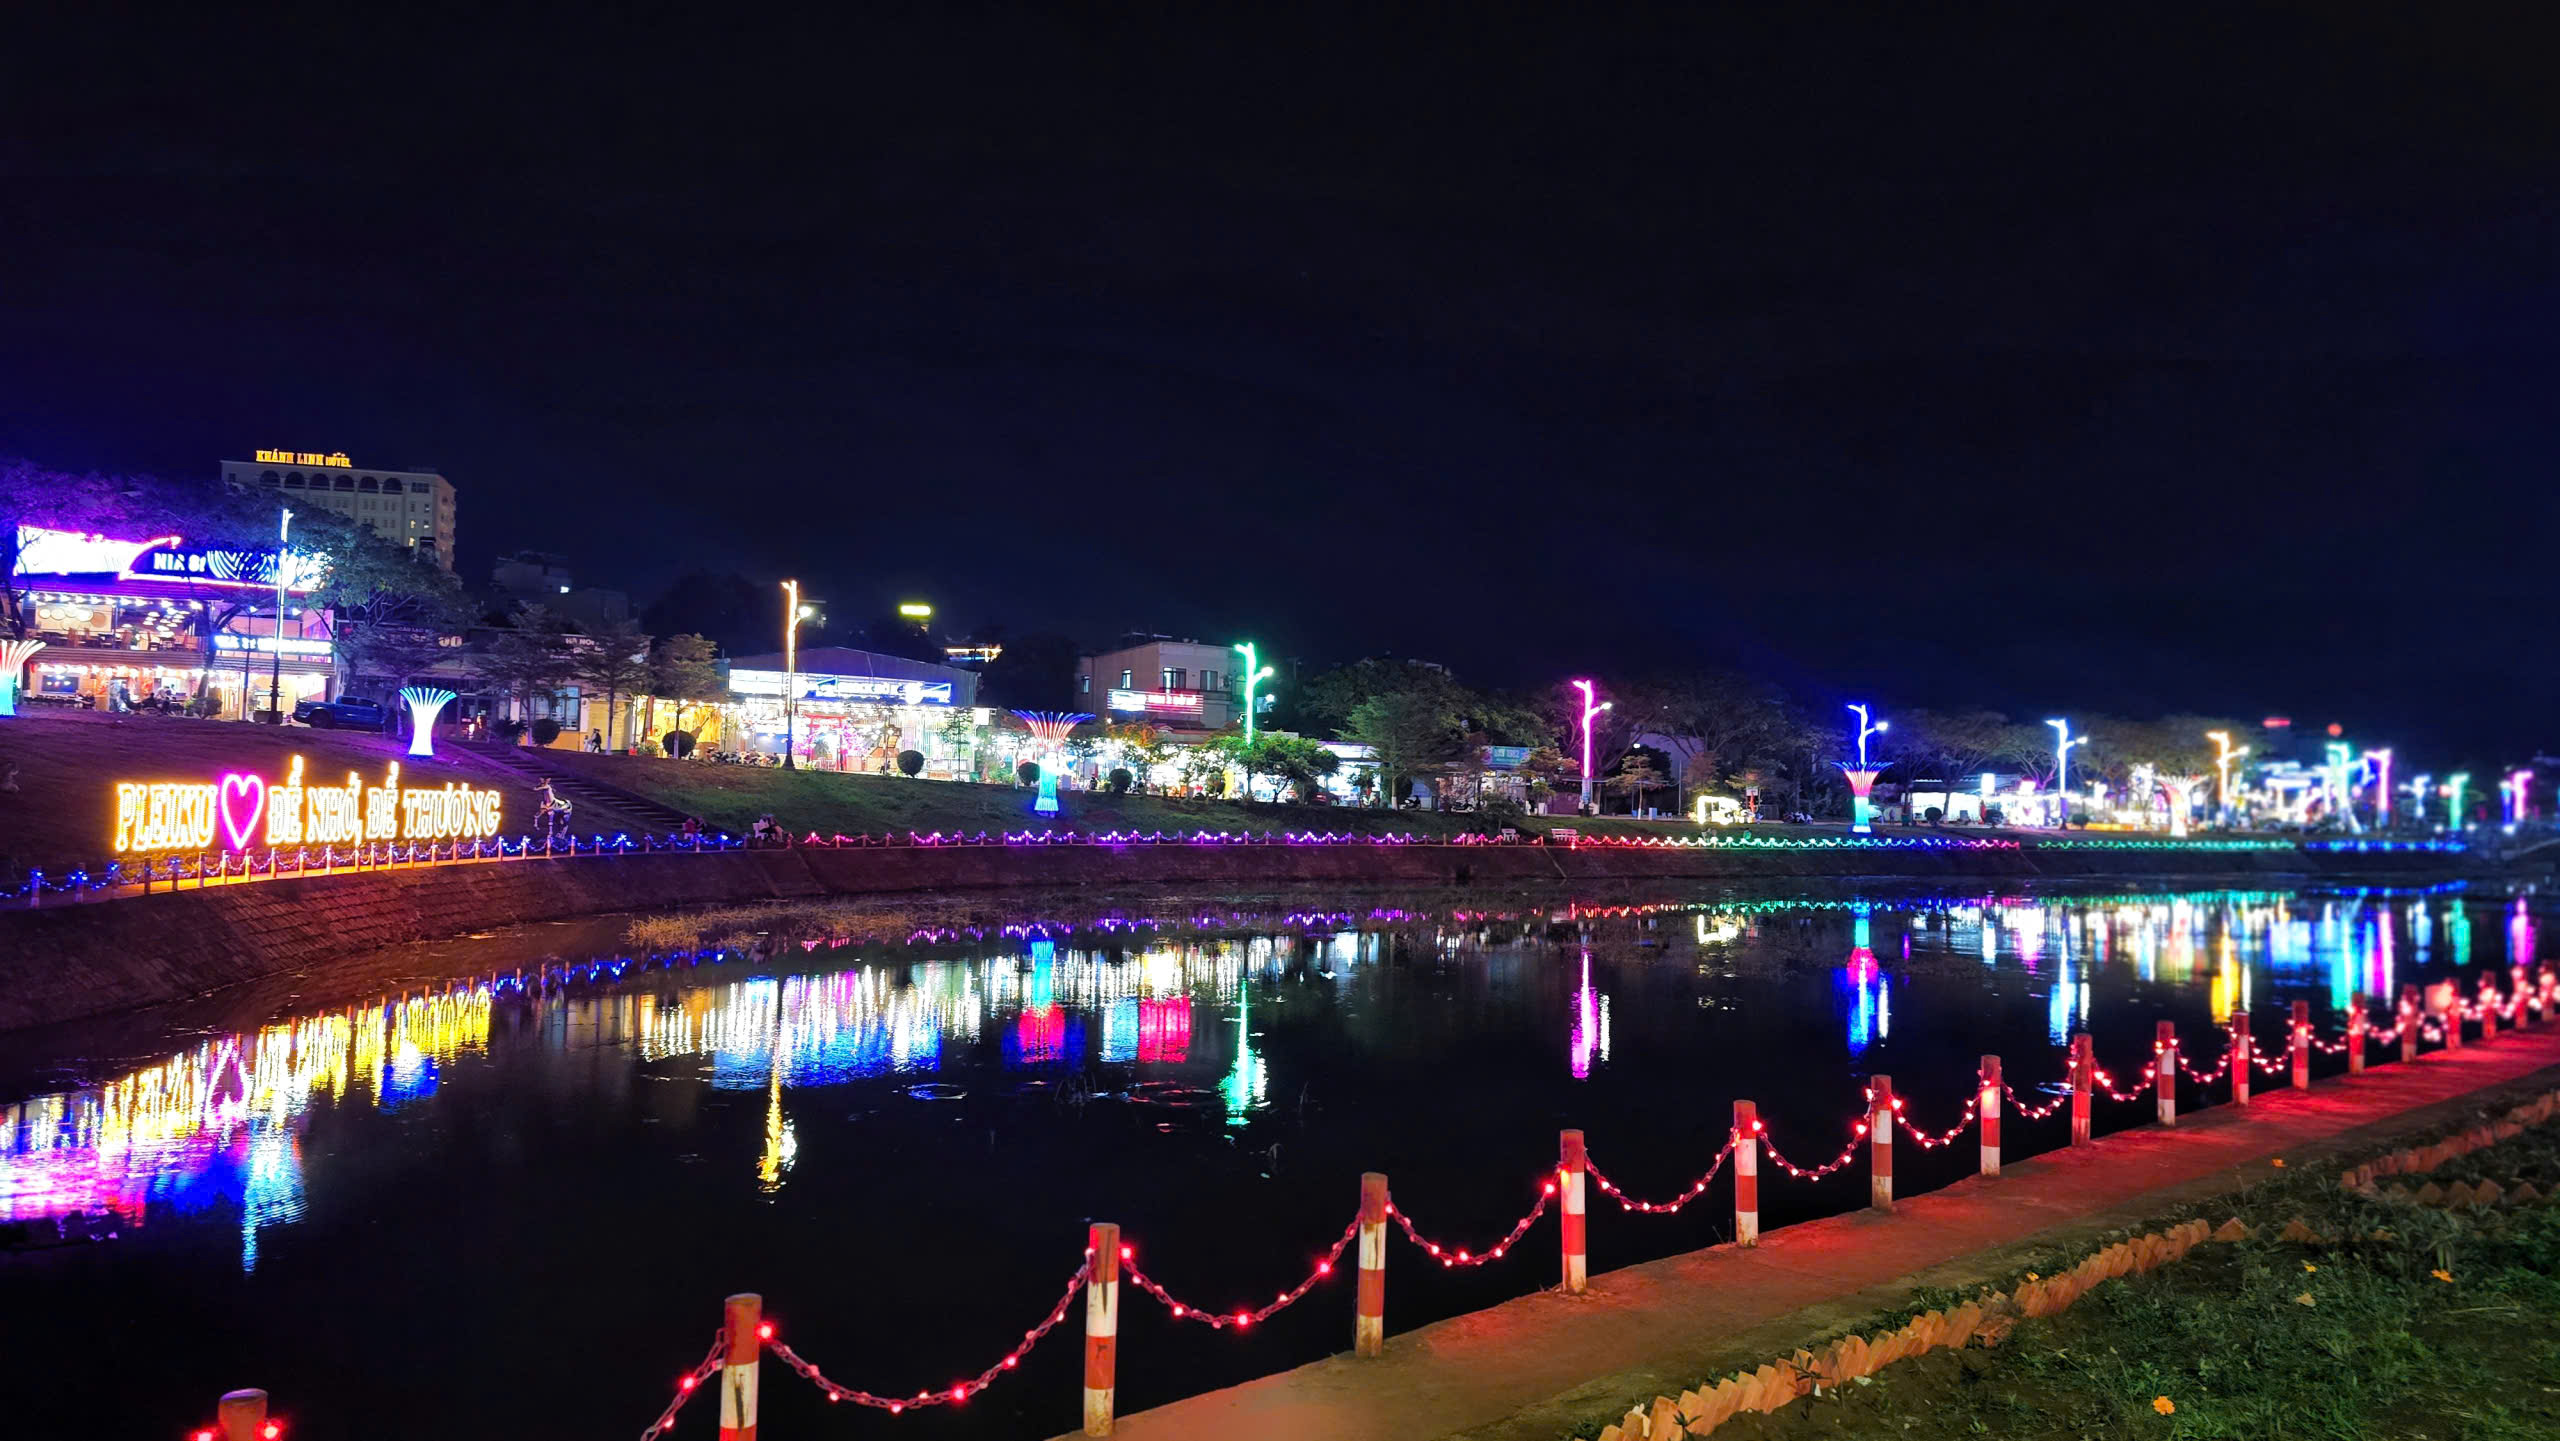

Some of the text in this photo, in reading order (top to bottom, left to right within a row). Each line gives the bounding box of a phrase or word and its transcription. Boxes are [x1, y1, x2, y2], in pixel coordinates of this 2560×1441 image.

[256, 448, 352, 468] KHÁNH LINH HOTEL
[115, 783, 218, 851] PLEIKU
[403, 782, 501, 838] THƯƠNG
